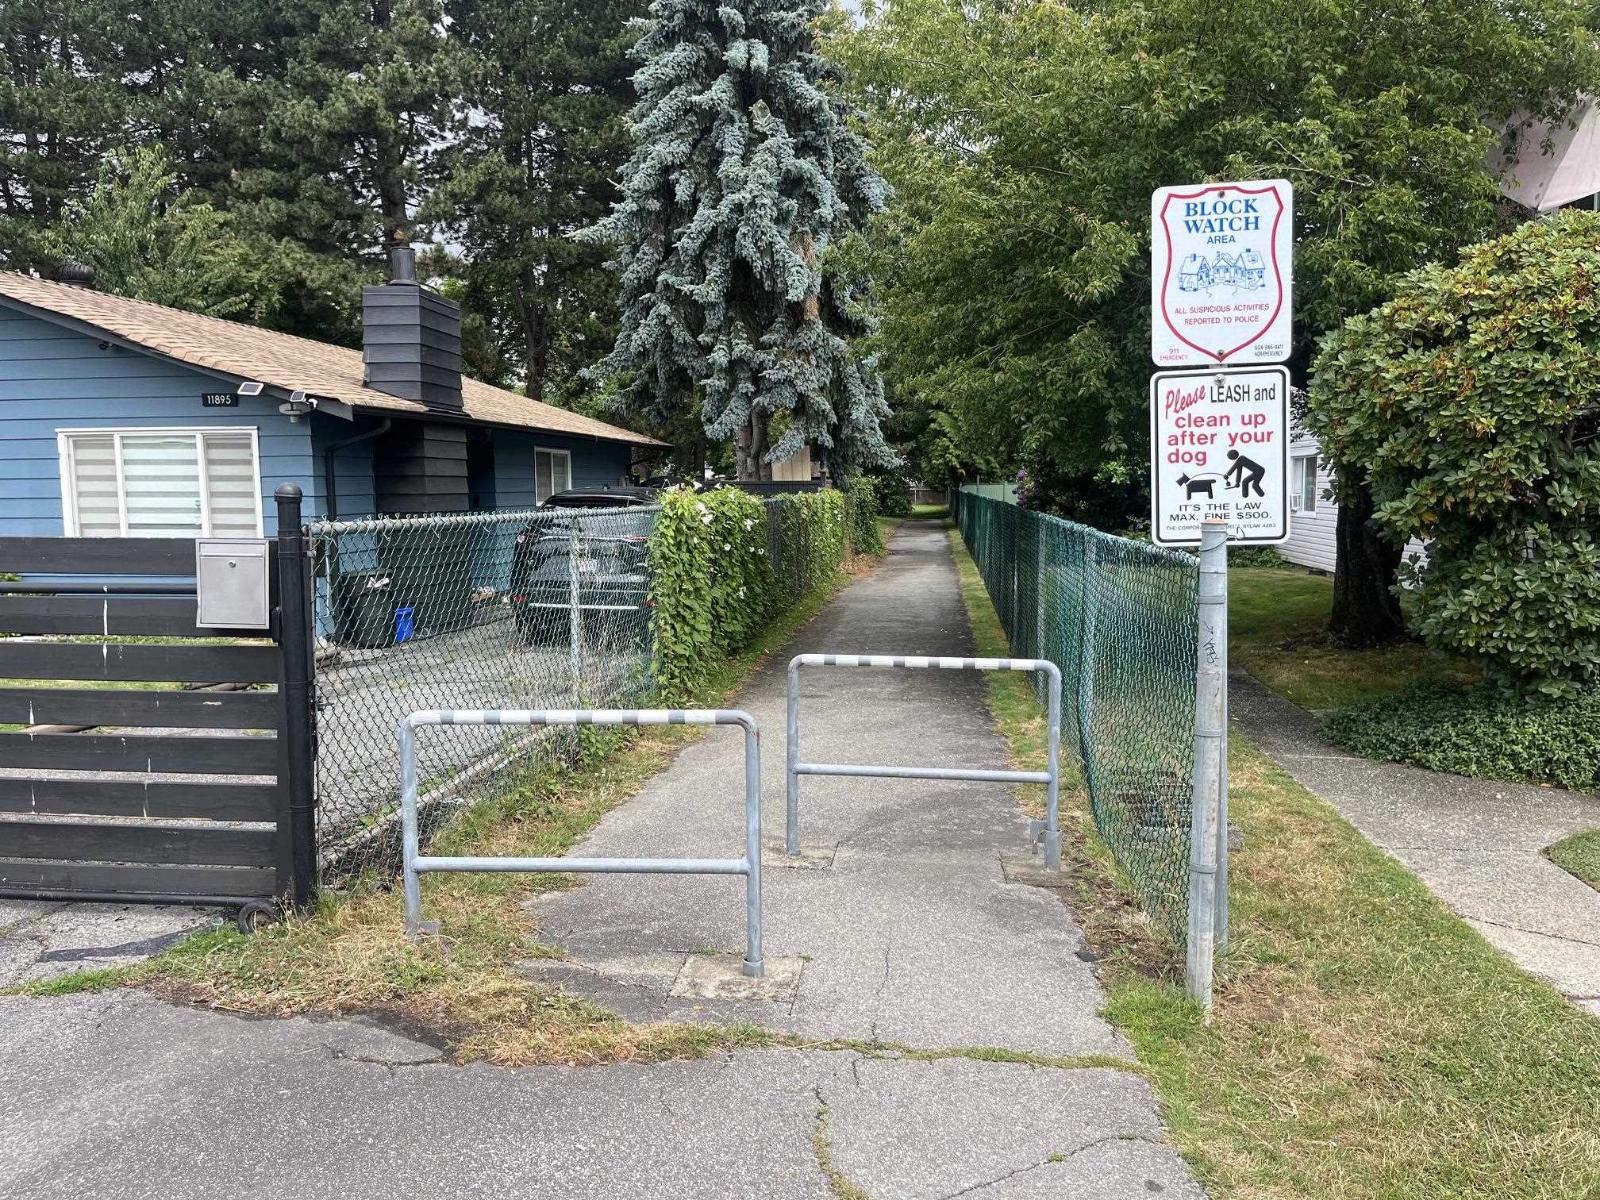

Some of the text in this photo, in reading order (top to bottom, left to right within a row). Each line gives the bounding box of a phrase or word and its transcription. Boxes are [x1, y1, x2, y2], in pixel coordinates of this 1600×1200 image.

[1185, 199, 1258, 217] BLOCK
[1184, 216, 1260, 233] WATCH
[1207, 235, 1236, 244] AREA
[1189, 305, 1231, 314] SUSPICIOUS
[1233, 303, 1270, 312] ACTIVITIES
[1184, 315, 1260, 325] REPORTED TO POLICE
[207, 395, 231, 404] 11895
[1165, 383, 1276, 419] Please LEASH and
[1175, 413, 1266, 428] clean up
[1167, 430, 1274, 447] after your
[1167, 448, 1207, 466] dog
[1179, 502, 1261, 512] IT'S THE LAW
[1169, 511, 1273, 521] MAX. FINE $500.
